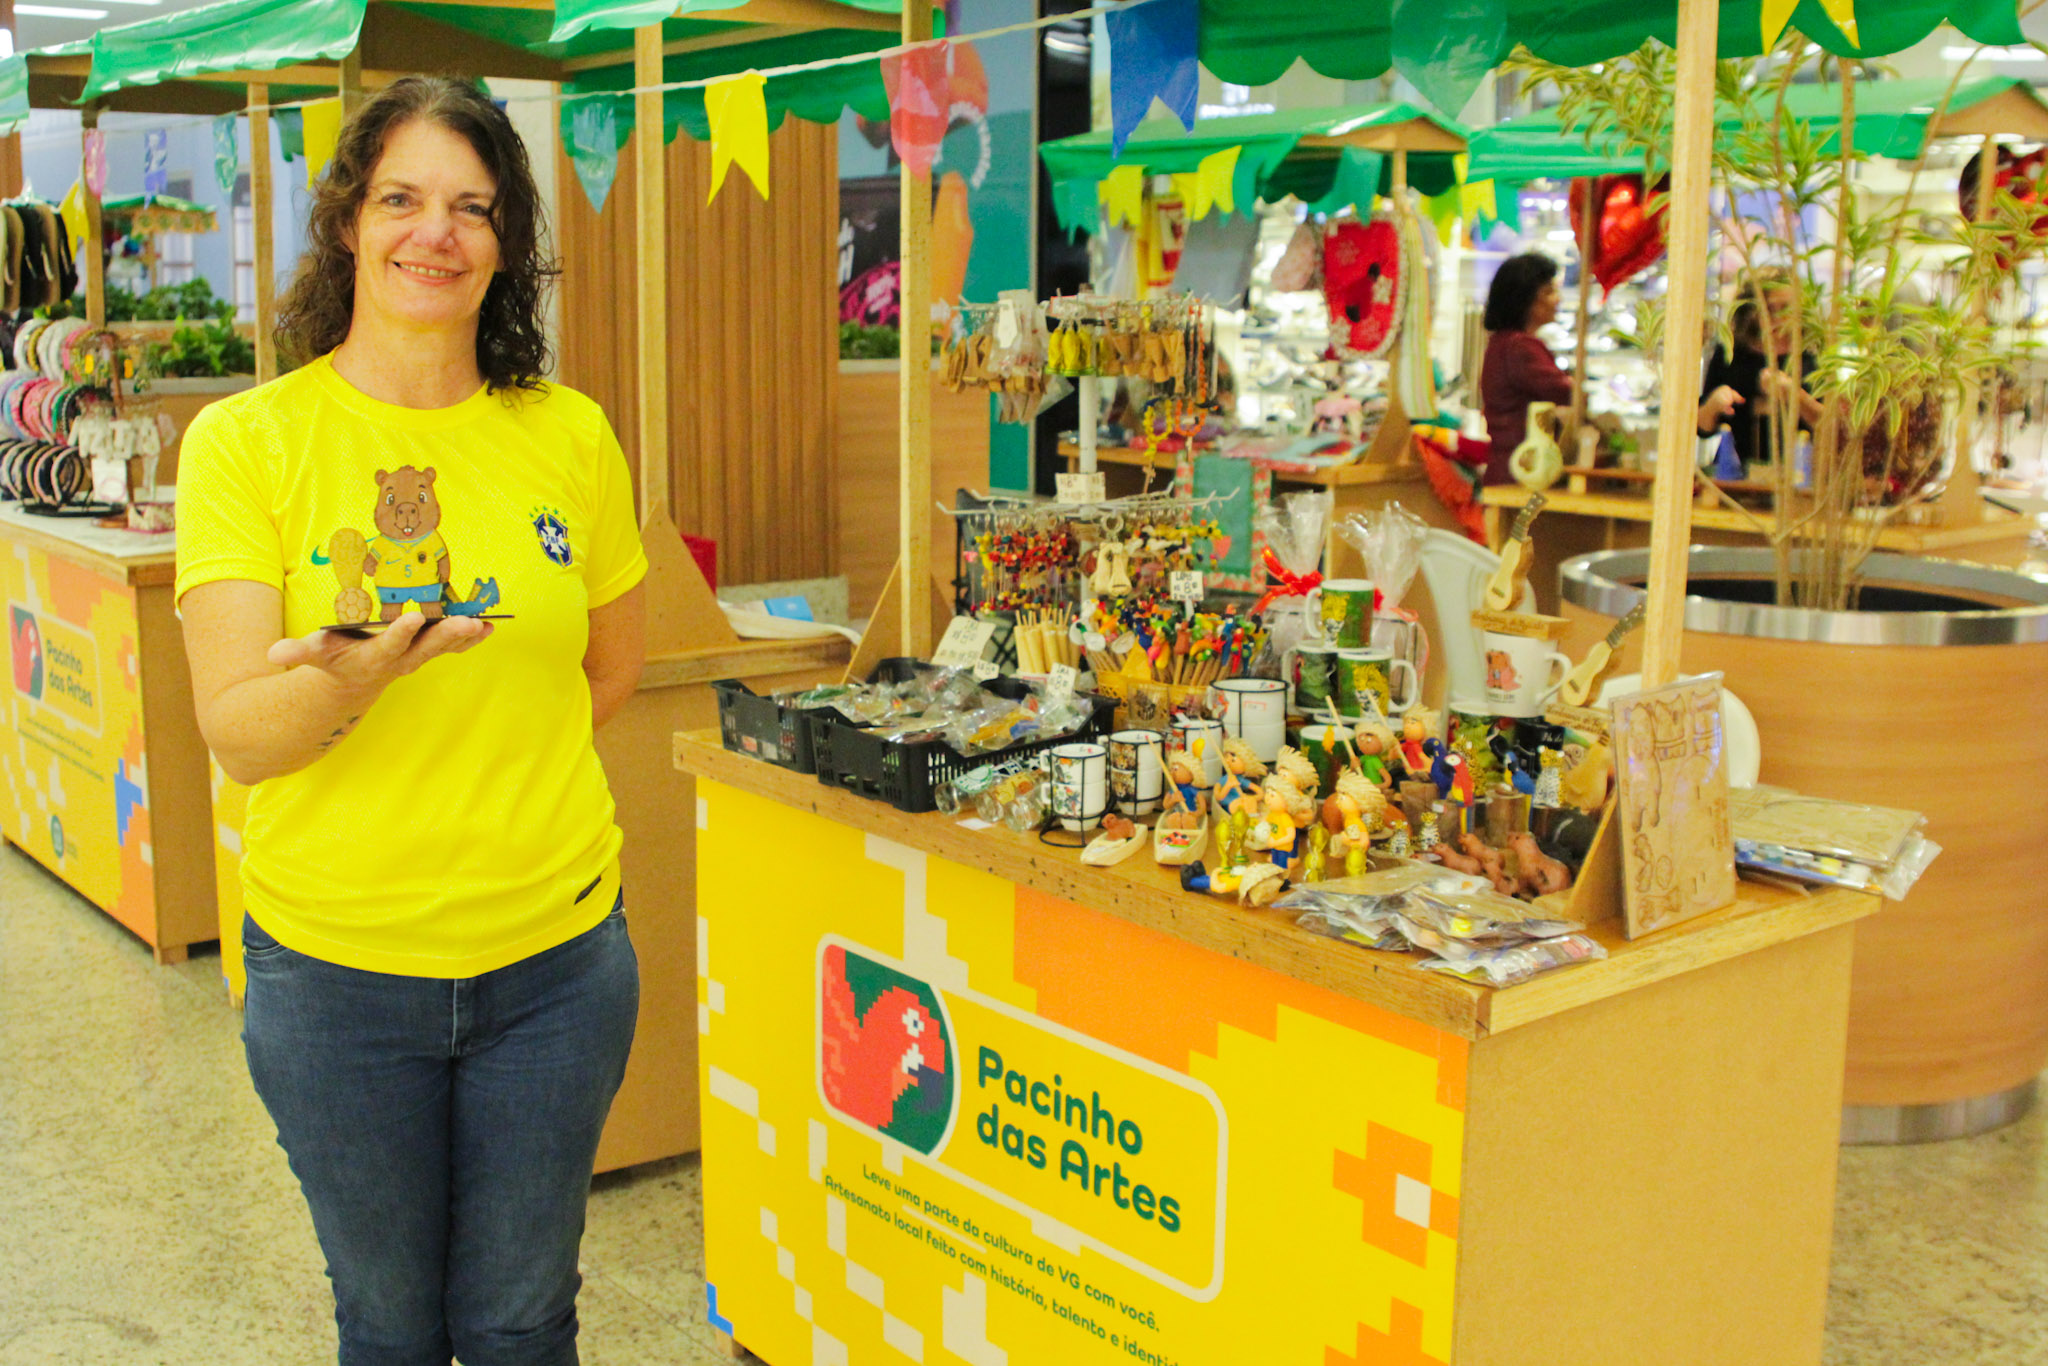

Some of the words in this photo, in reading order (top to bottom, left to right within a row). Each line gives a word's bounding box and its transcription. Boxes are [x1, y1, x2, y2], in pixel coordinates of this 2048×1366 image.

[404, 564, 412, 578] 5
[545, 534, 559, 545] CBF
[978, 1045, 1143, 1156] Pacinho
[976, 1103, 1047, 1170] das
[1060, 1139, 1181, 1233] Artes
[825, 1174, 891, 1223] Artesanato
[894, 1211, 923, 1240] local
[926, 1229, 956, 1259] feito
[960, 1252, 987, 1276] com
[990, 1264, 1048, 1312] história,
[1052, 1298, 1106, 1339] talento
[1110, 1333, 1119, 1347] e
[1123, 1334, 1178, 1366] identi
[863, 1163, 891, 1190] Leve
[894, 1184, 920, 1207] uma
[924, 1200, 959, 1226] parte
[963, 1218, 980, 1237] da
[983, 1231, 1033, 1266] cultura
[1037, 1257, 1055, 1277] de
[1058, 1265, 1080, 1290] VG
[1084, 1284, 1116, 1309] com
[1119, 1301, 1160, 1333] você.
